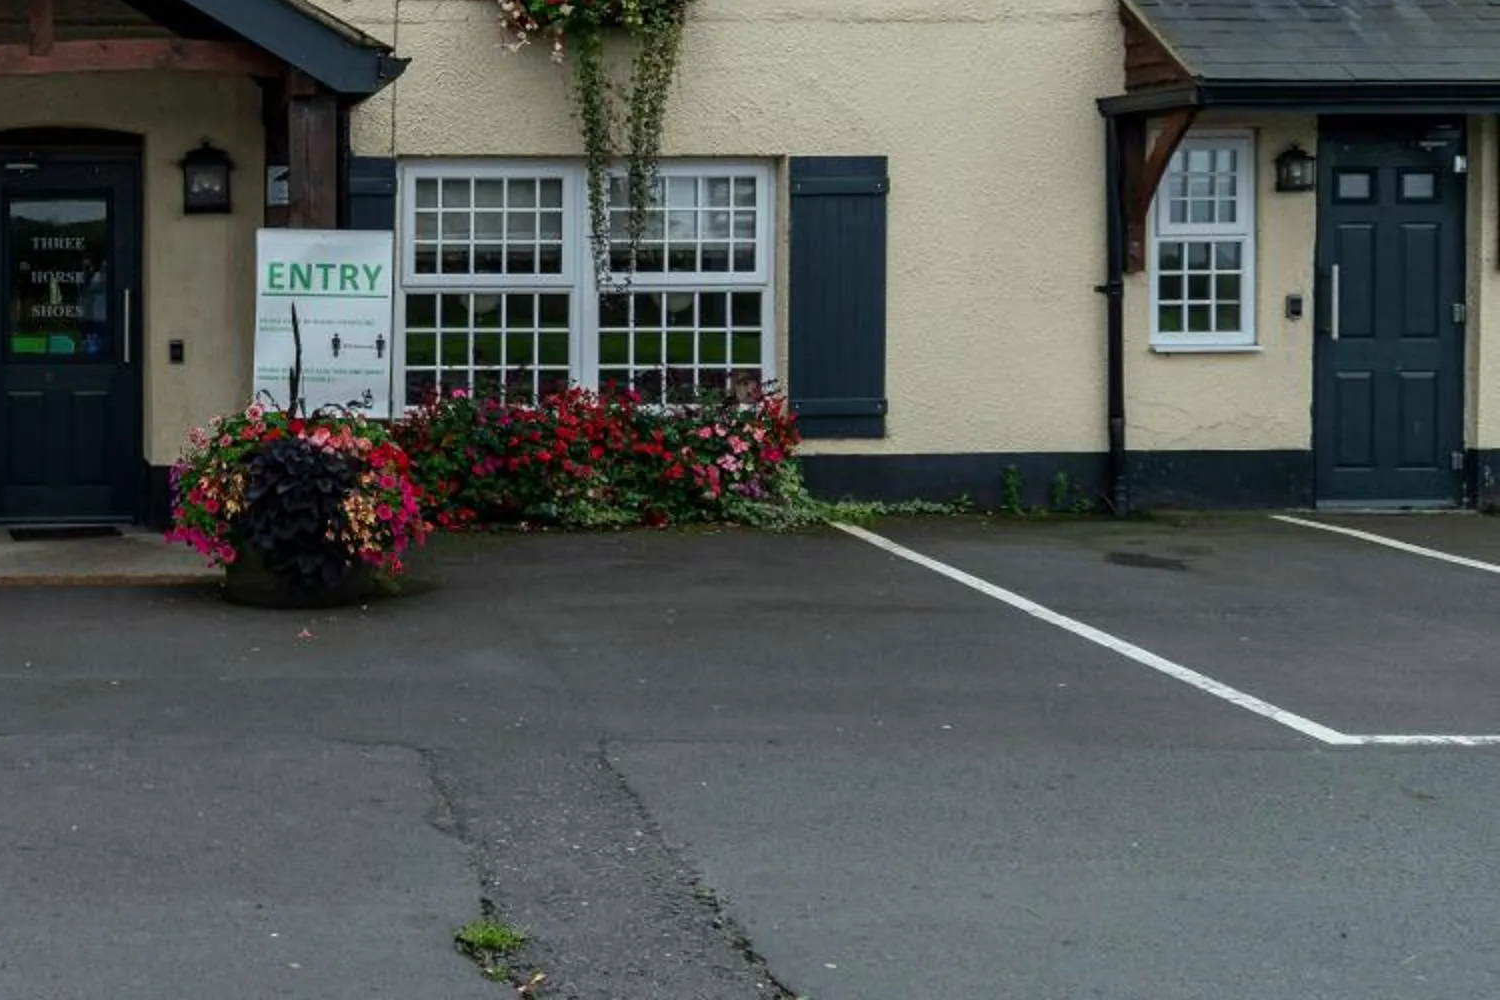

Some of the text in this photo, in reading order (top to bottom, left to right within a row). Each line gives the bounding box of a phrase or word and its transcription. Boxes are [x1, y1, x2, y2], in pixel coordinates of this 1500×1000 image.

[31, 237, 85, 250] THREE
[31, 271, 85, 284] HORSE
[268, 263, 383, 291] ENTRY
[31, 305, 85, 317] SHOES
